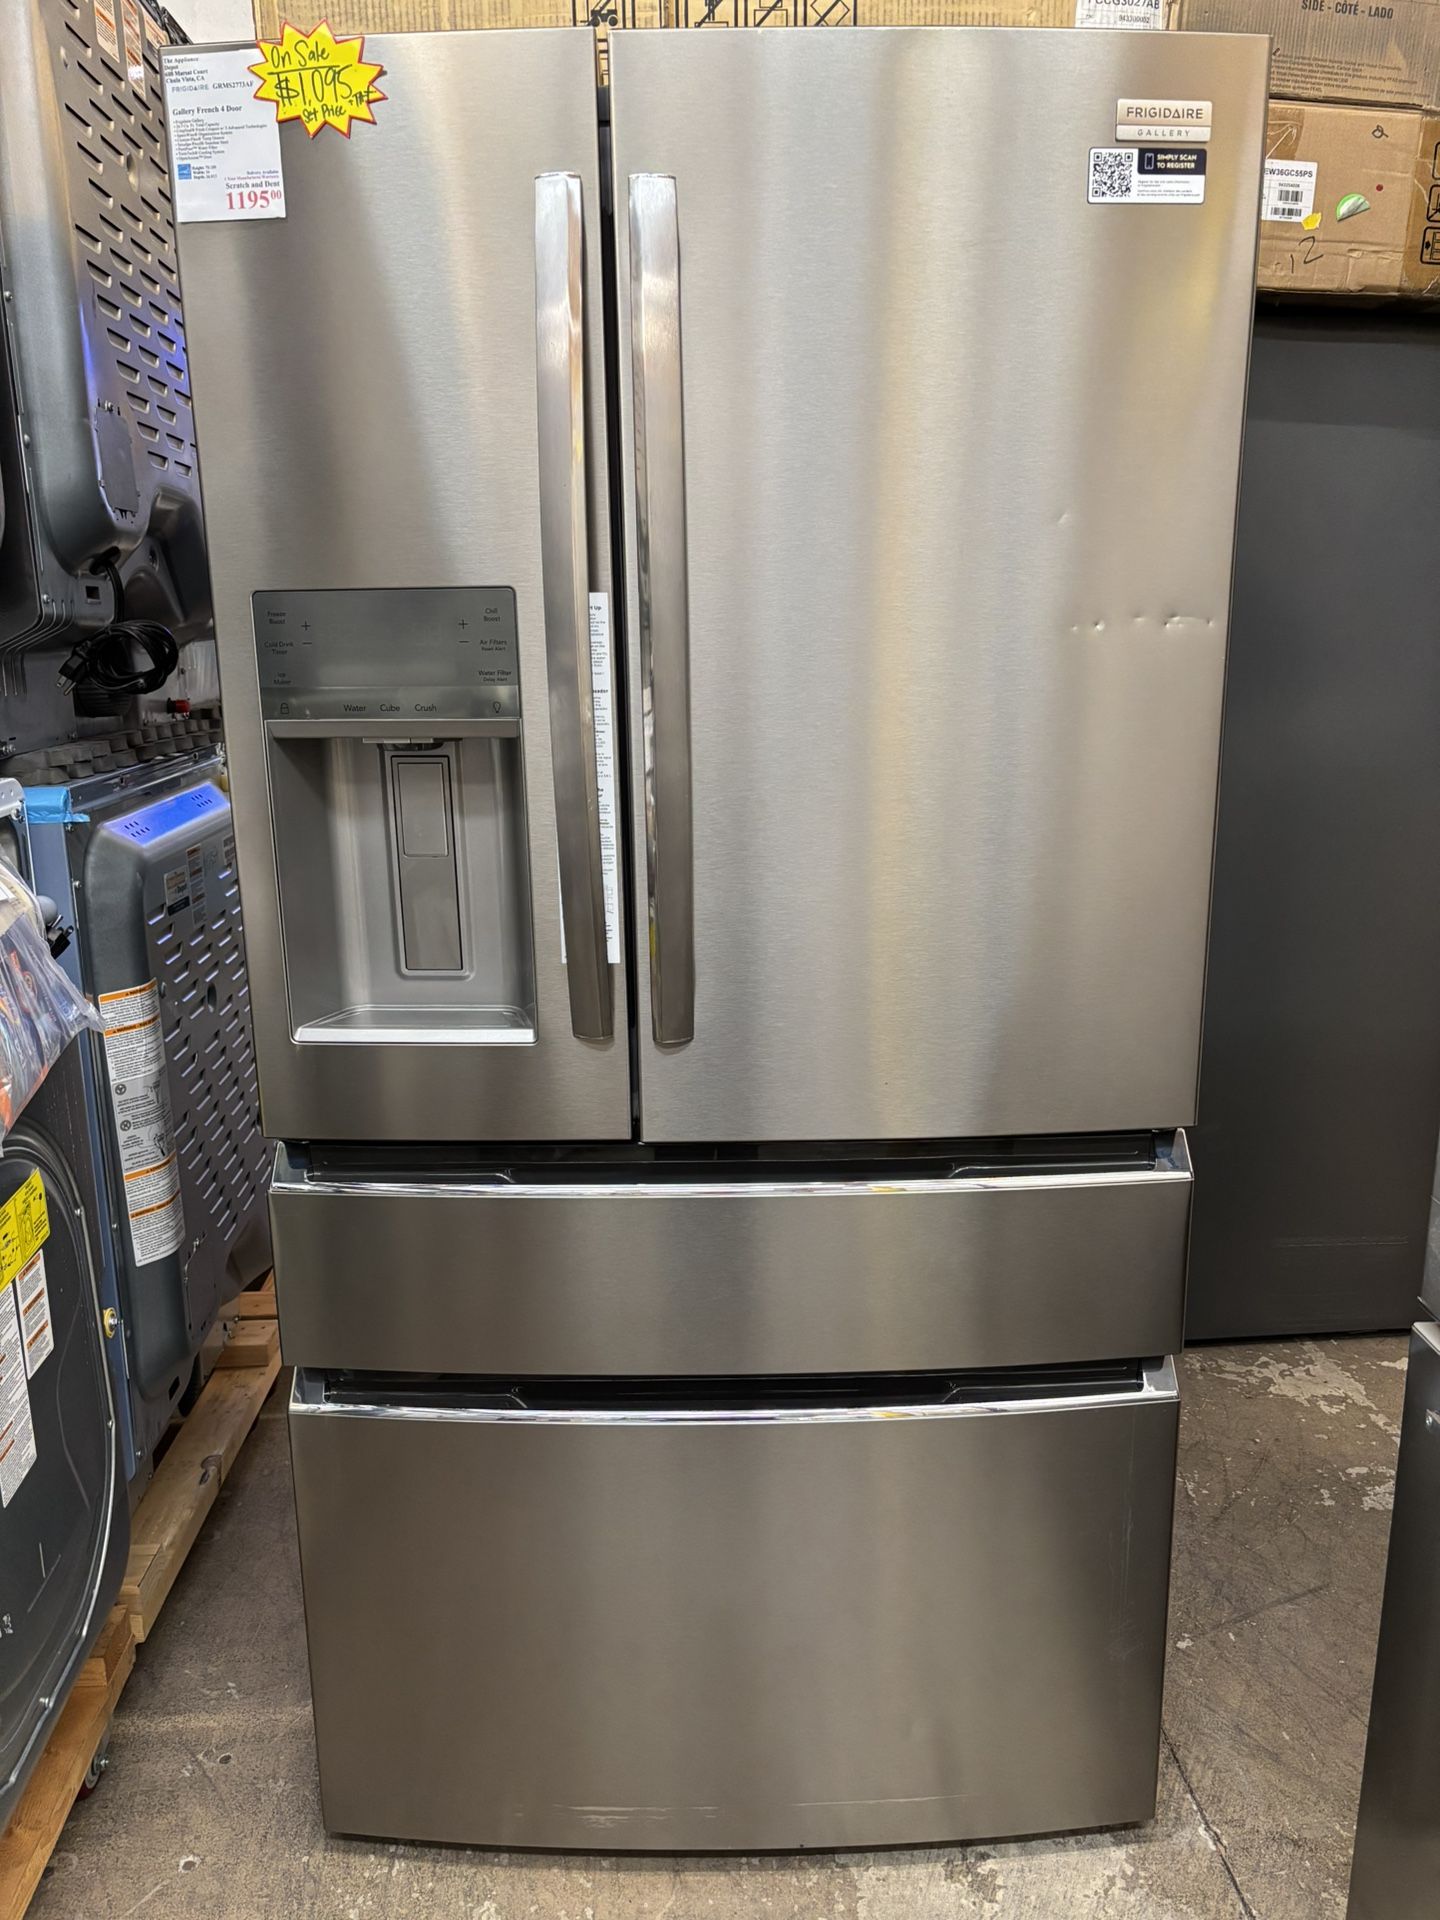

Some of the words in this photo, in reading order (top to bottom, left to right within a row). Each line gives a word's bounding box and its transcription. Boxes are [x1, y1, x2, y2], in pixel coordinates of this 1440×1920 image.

[1302, 0, 1324, 12] SIDE
[1335, 1, 1358, 16] CÔTÉ
[1368, 6, 1393, 19] LADO
[271, 46, 291, 68] On
[294, 40, 329, 67] Sale
[172, 84, 209, 92] FRIGIDAIRE
[1126, 107, 1204, 119] FRIGIDAIRE
[344, 704, 366, 712] Water
[380, 704, 400, 712] Cube
[414, 704, 437, 712] Crush
